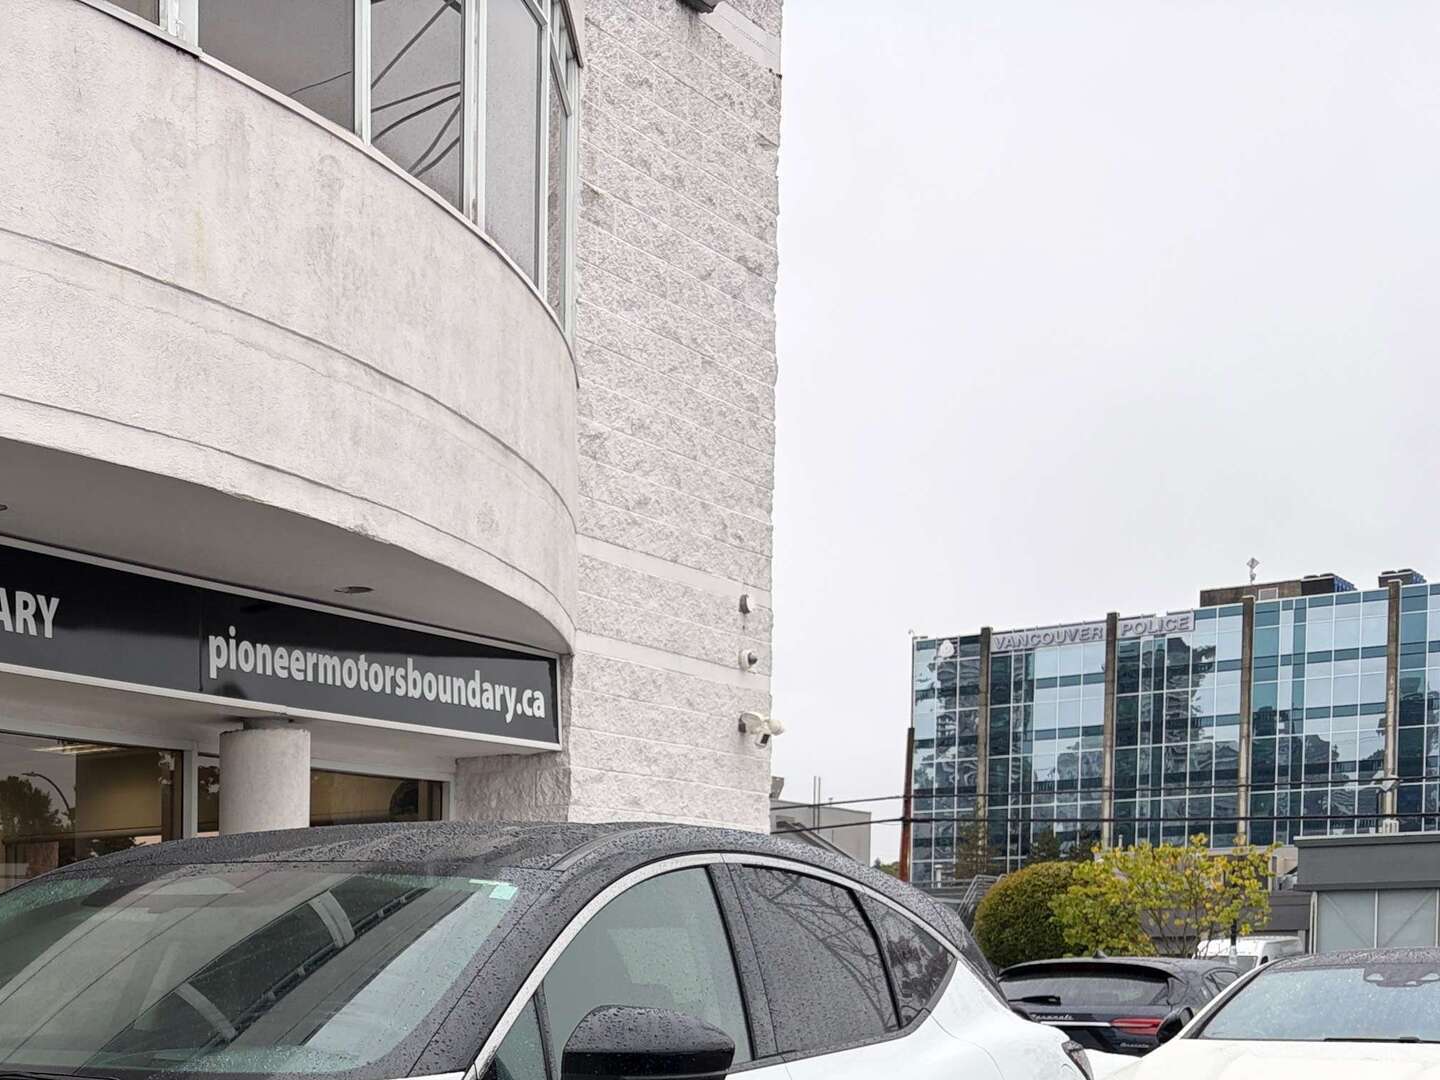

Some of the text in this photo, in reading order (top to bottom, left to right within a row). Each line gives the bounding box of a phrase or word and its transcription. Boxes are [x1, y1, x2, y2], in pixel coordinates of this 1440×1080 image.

[994, 615, 1190, 650] VANCOUVER POLICE
[207, 626, 546, 722] pioneermotorsboundary.ca
